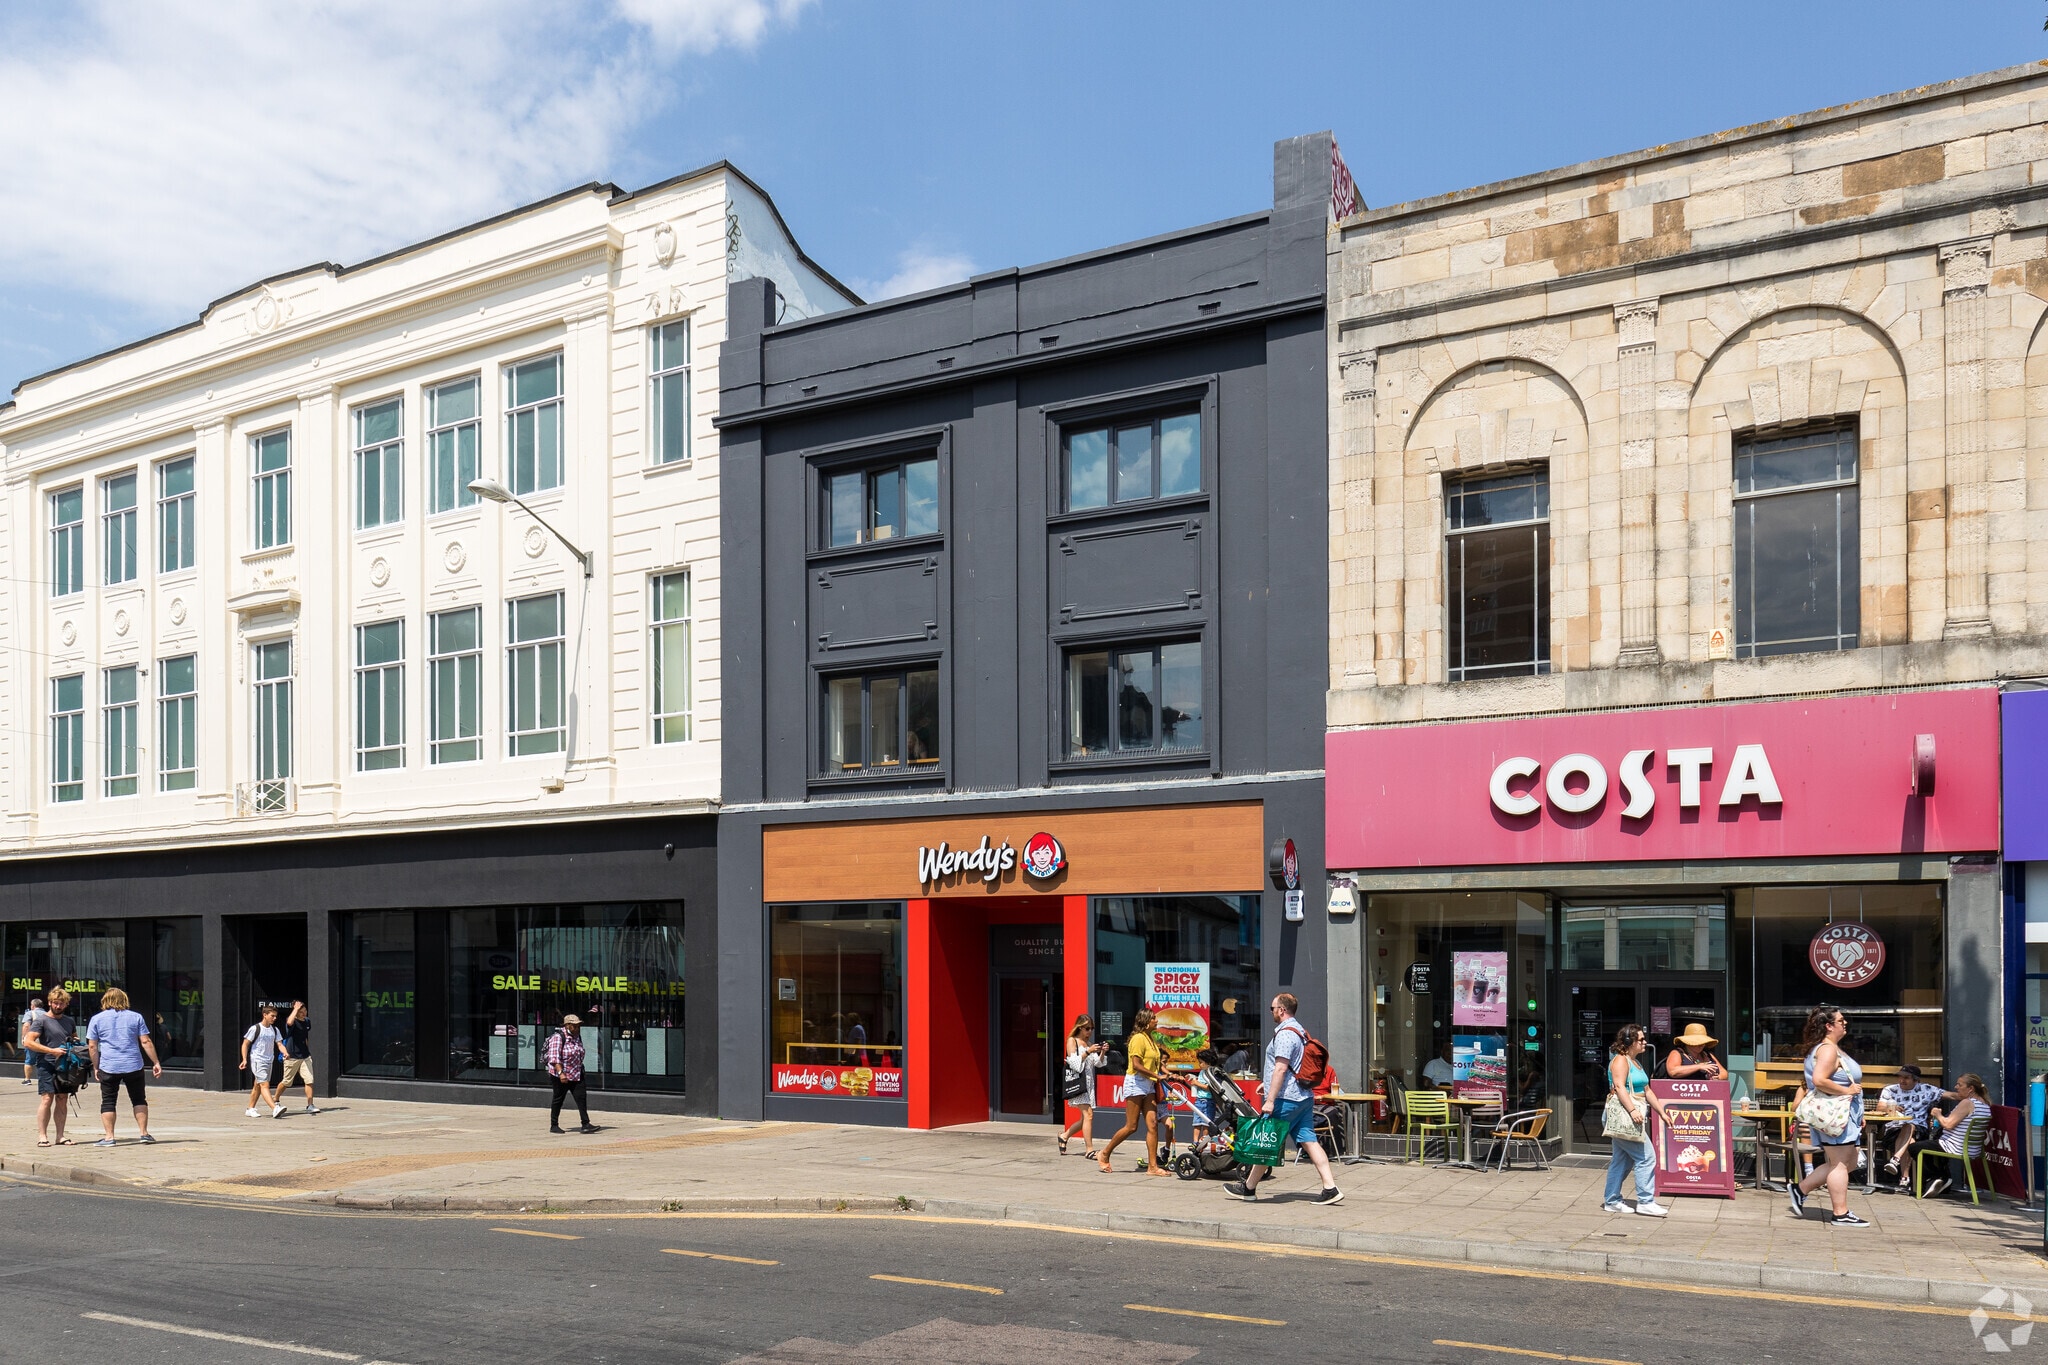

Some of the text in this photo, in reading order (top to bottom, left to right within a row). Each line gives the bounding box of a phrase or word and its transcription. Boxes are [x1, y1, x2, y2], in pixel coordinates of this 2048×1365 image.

[1489, 744, 1784, 819] COSTA
[918, 835, 1015, 884] Wendy's
[1823, 927, 1869, 944] COSTA
[1820, 960, 1876, 981] COFFEE
[12, 978, 42, 990] SALE
[492, 975, 541, 990] SALE
[576, 976, 628, 992] SALE
[1154, 973, 1200, 985] SPICY
[65, 980, 96, 992] SALE
[366, 991, 414, 1008] SALE
[2029, 1027, 2046, 1037] All
[1453, 1061, 1475, 1069] COSTA
[778, 1069, 818, 1089] Wendy's
[875, 1073, 900, 1082] NOW
[1671, 1083, 1709, 1092] COSTA
[1252, 1132, 1277, 1142] M&S
